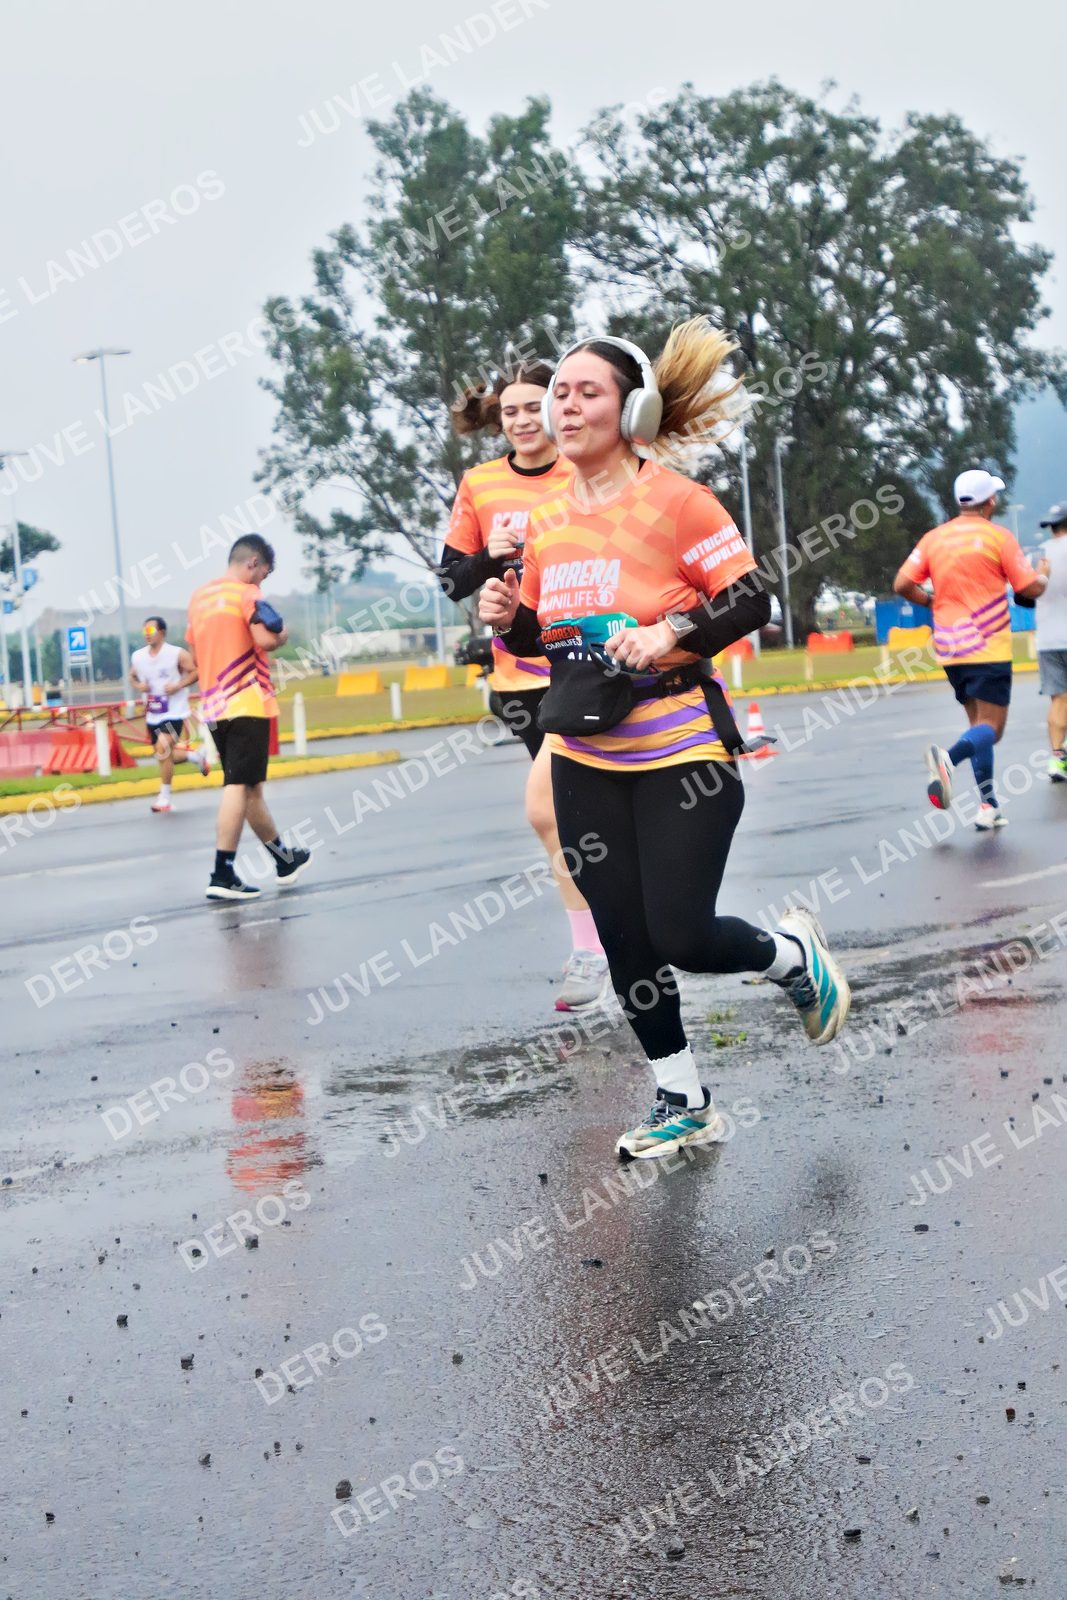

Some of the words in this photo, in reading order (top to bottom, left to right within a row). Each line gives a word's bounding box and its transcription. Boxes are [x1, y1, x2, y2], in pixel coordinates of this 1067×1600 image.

[541, 558, 621, 595] CARRERA
[541, 625, 581, 643] CARRERA
[545, 638, 576, 650] OMNILIFE
